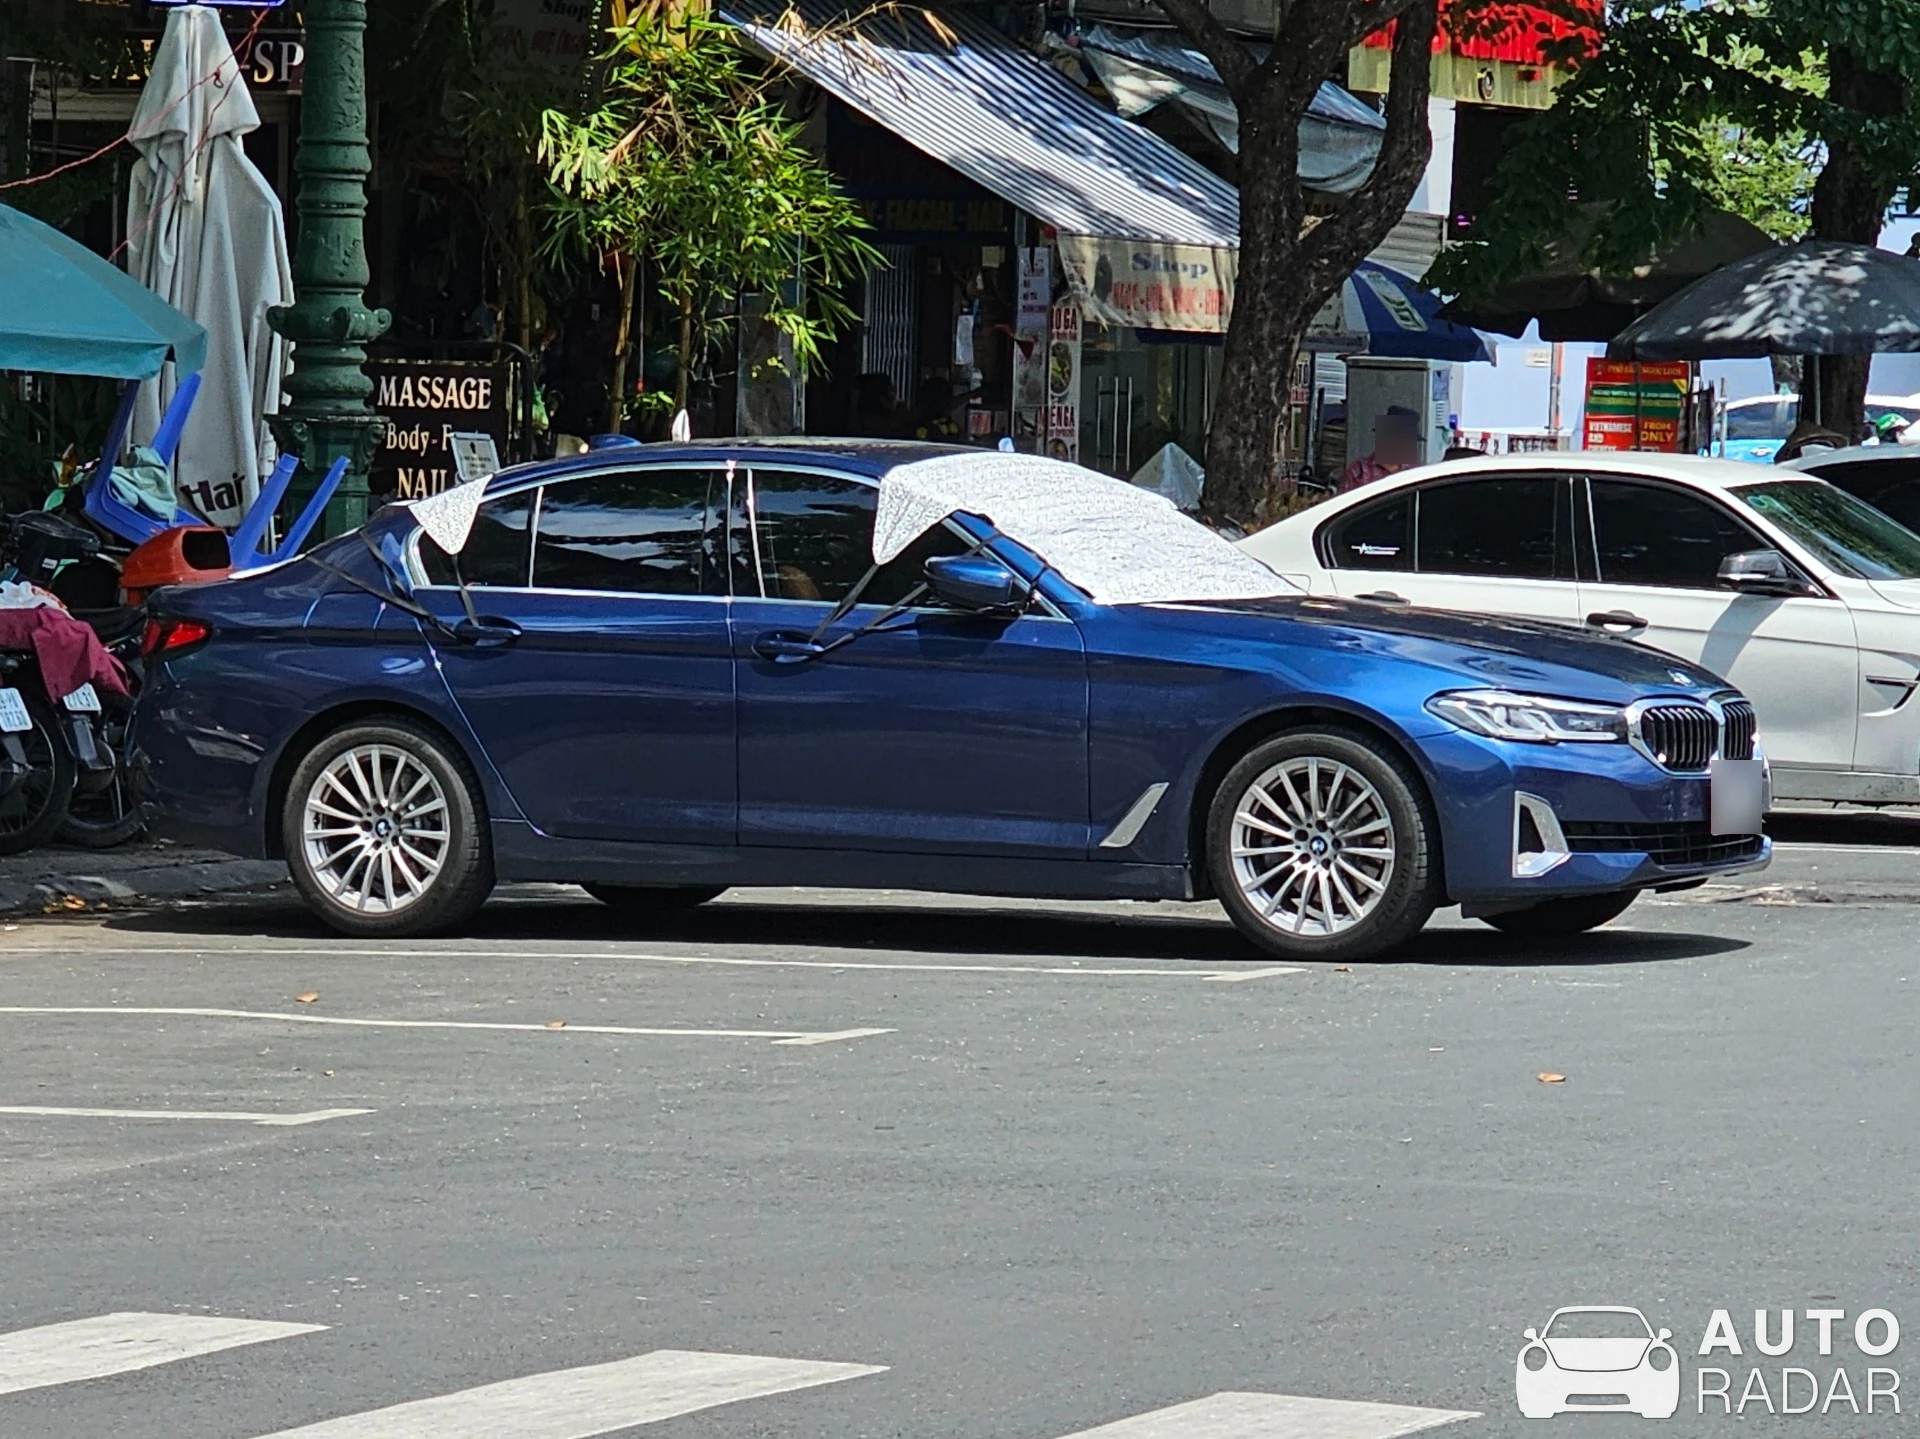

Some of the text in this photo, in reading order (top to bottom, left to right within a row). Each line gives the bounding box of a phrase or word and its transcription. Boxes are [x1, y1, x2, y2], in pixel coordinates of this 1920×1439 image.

[1131, 252, 1208, 279] Shop
[377, 375, 492, 410] MASSAGE
[1643, 421, 1672, 430] FROM
